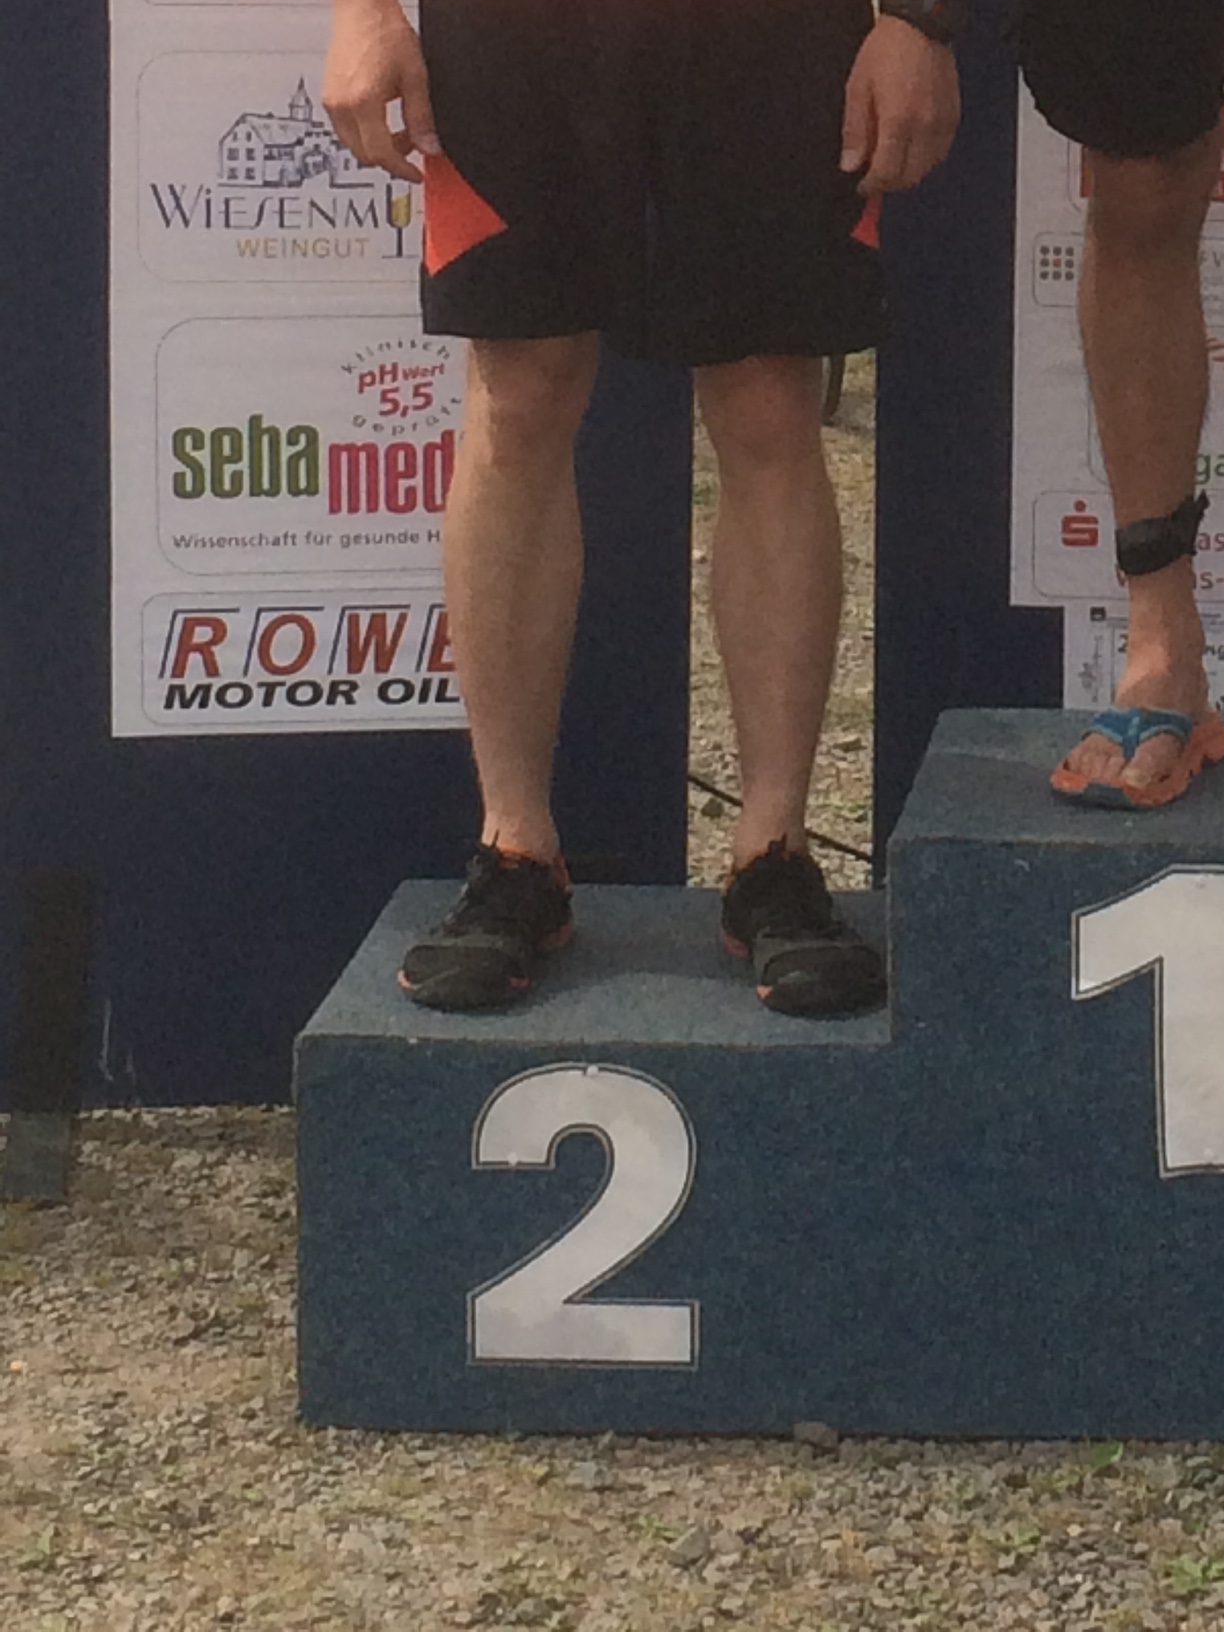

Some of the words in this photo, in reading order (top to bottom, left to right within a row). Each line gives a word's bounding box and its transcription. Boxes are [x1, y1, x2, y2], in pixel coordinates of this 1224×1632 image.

[237, 237, 371, 260] WEINGUT
[358, 362, 399, 394] pH
[402, 363, 446, 382] Wert
[378, 381, 435, 418] 5,5
[172, 529, 297, 550] Wissenschaft
[304, 528, 332, 548] für
[340, 529, 420, 549] gesunde
[164, 679, 358, 709] MOTOR
[467, 1064, 701, 1365] 2
